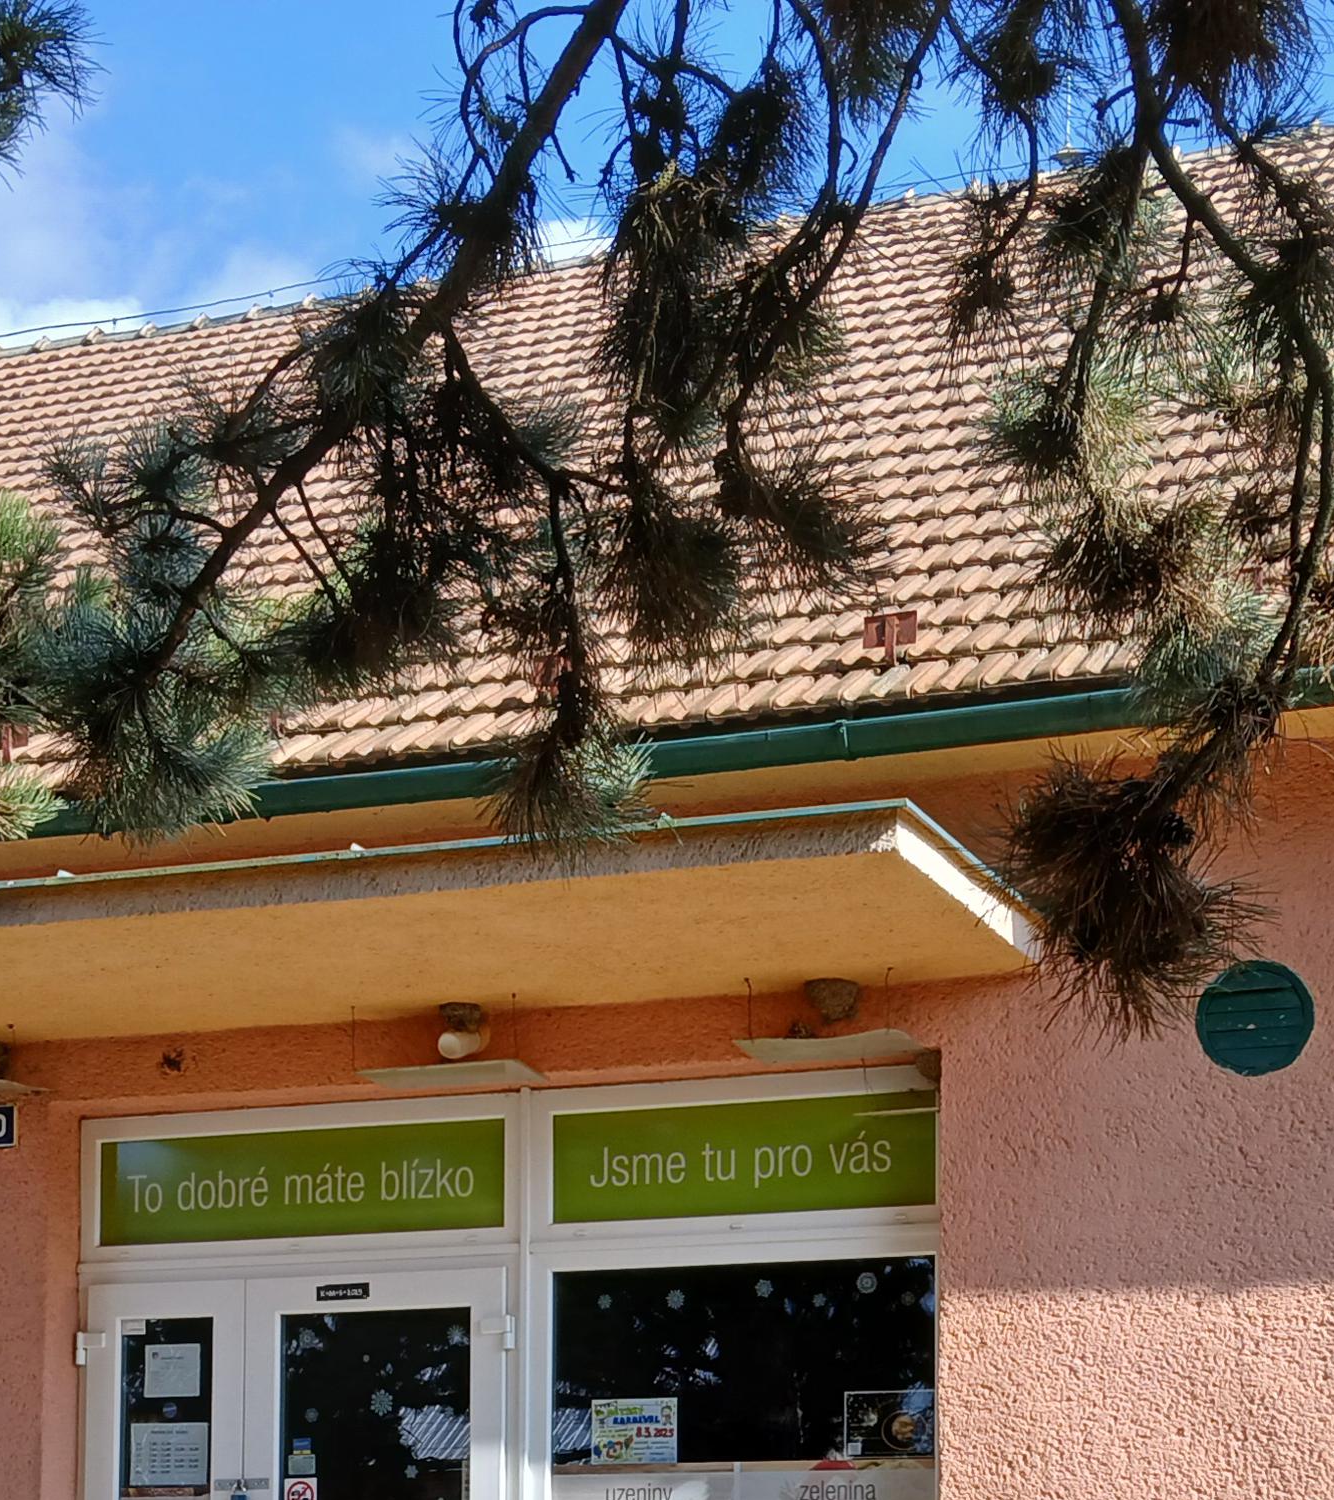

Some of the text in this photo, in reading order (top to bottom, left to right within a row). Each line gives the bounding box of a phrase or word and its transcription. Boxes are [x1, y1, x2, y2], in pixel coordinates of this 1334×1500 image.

[126, 1158, 475, 1213] To dobré máte blízko
[590, 1130, 892, 1188] Jsme tu pro vás
